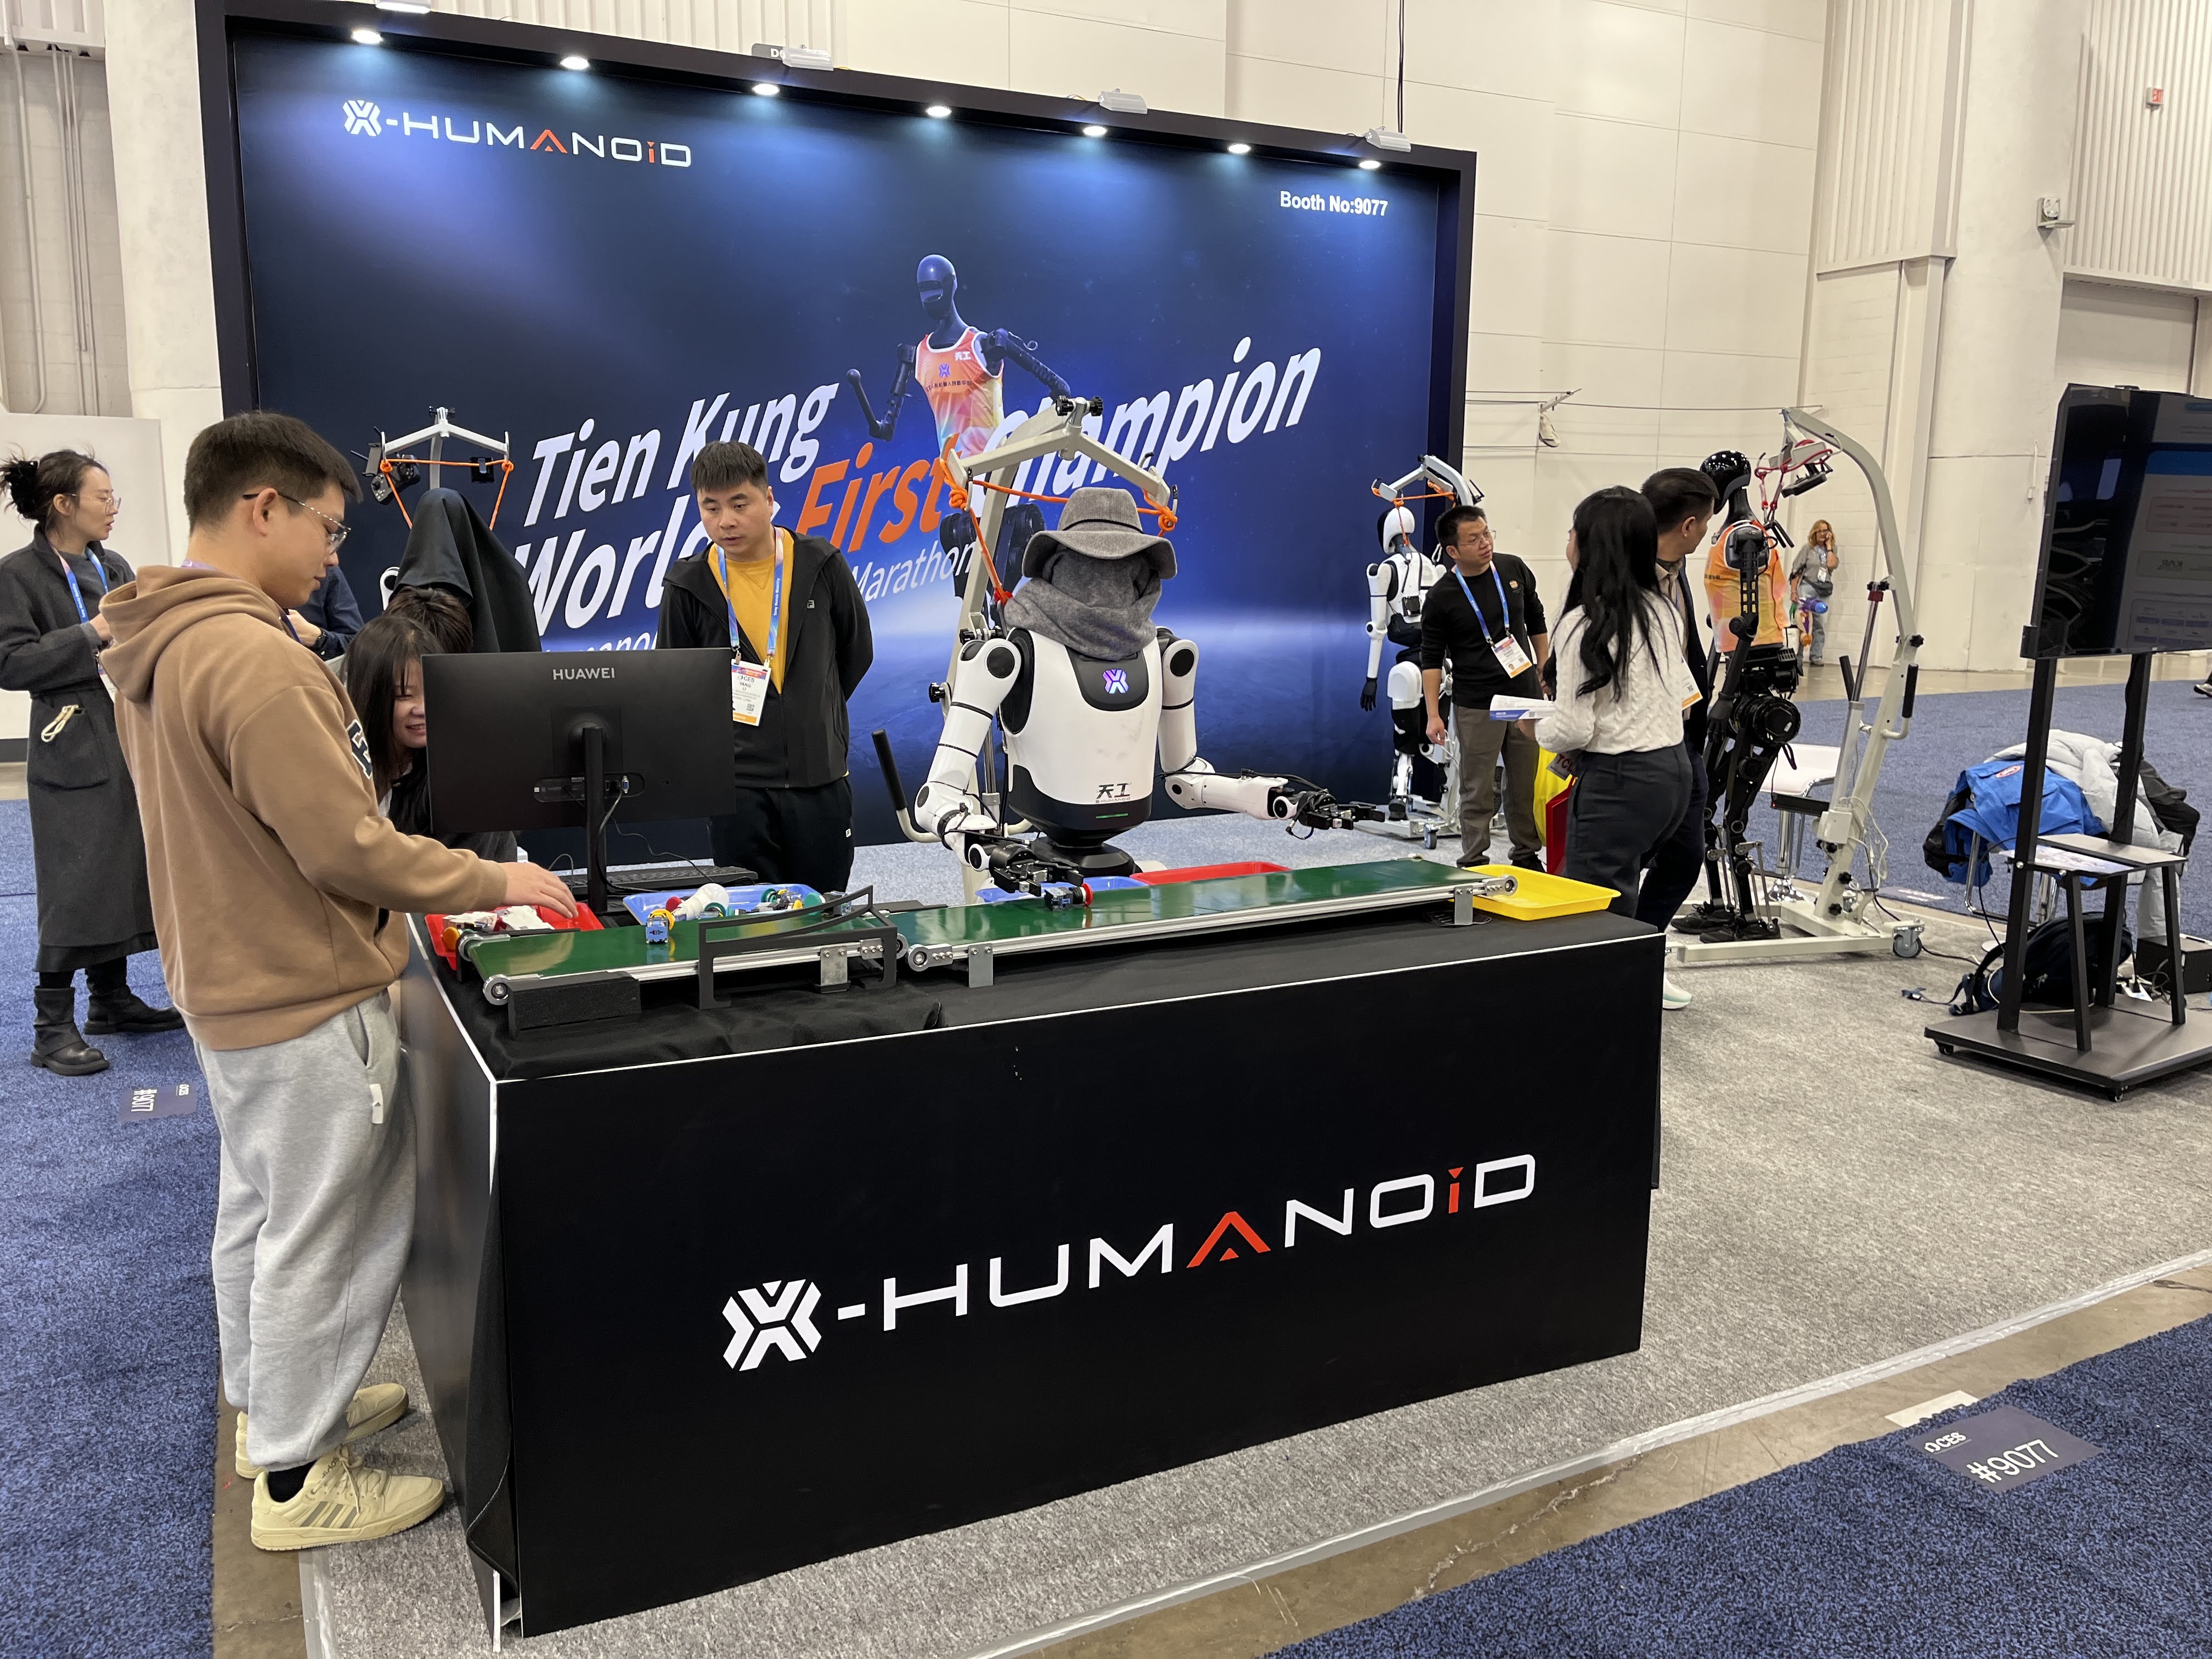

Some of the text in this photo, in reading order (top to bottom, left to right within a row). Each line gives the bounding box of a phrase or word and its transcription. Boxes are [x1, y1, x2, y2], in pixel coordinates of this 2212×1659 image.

[1280, 190, 1388, 216] Booth No:9077
[524, 382, 839, 527] Tien Kung
[795, 433, 962, 553] First
[851, 540, 977, 602] Marathon
[553, 667, 615, 680] HUAWEI
[1096, 782, 1131, 799] 天工
[1967, 1439, 2059, 1483] #9077
